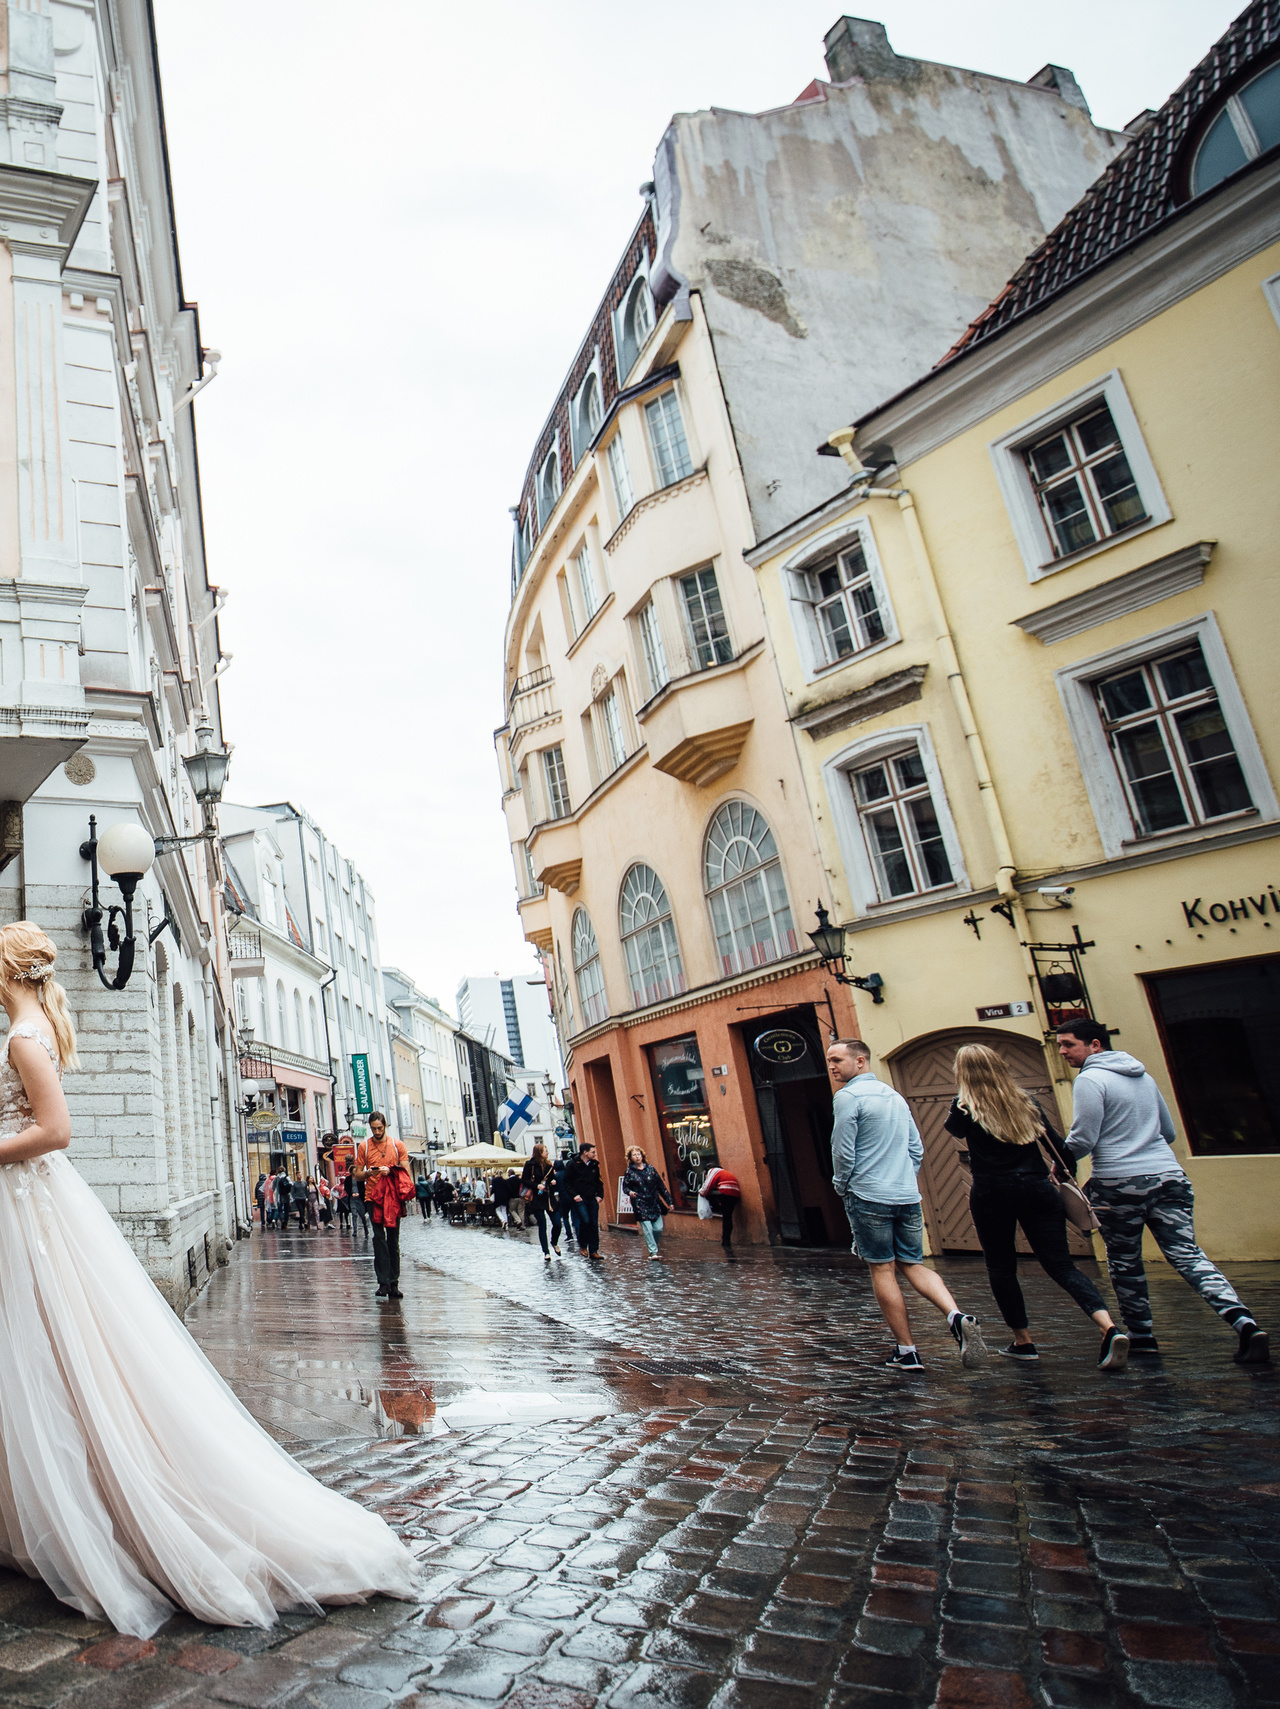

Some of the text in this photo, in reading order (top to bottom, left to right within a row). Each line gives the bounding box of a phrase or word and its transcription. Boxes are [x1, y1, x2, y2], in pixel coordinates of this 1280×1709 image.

[985, 1004, 1023, 1017] Viru 2
[356, 1059, 370, 1109] SALAMANDER
